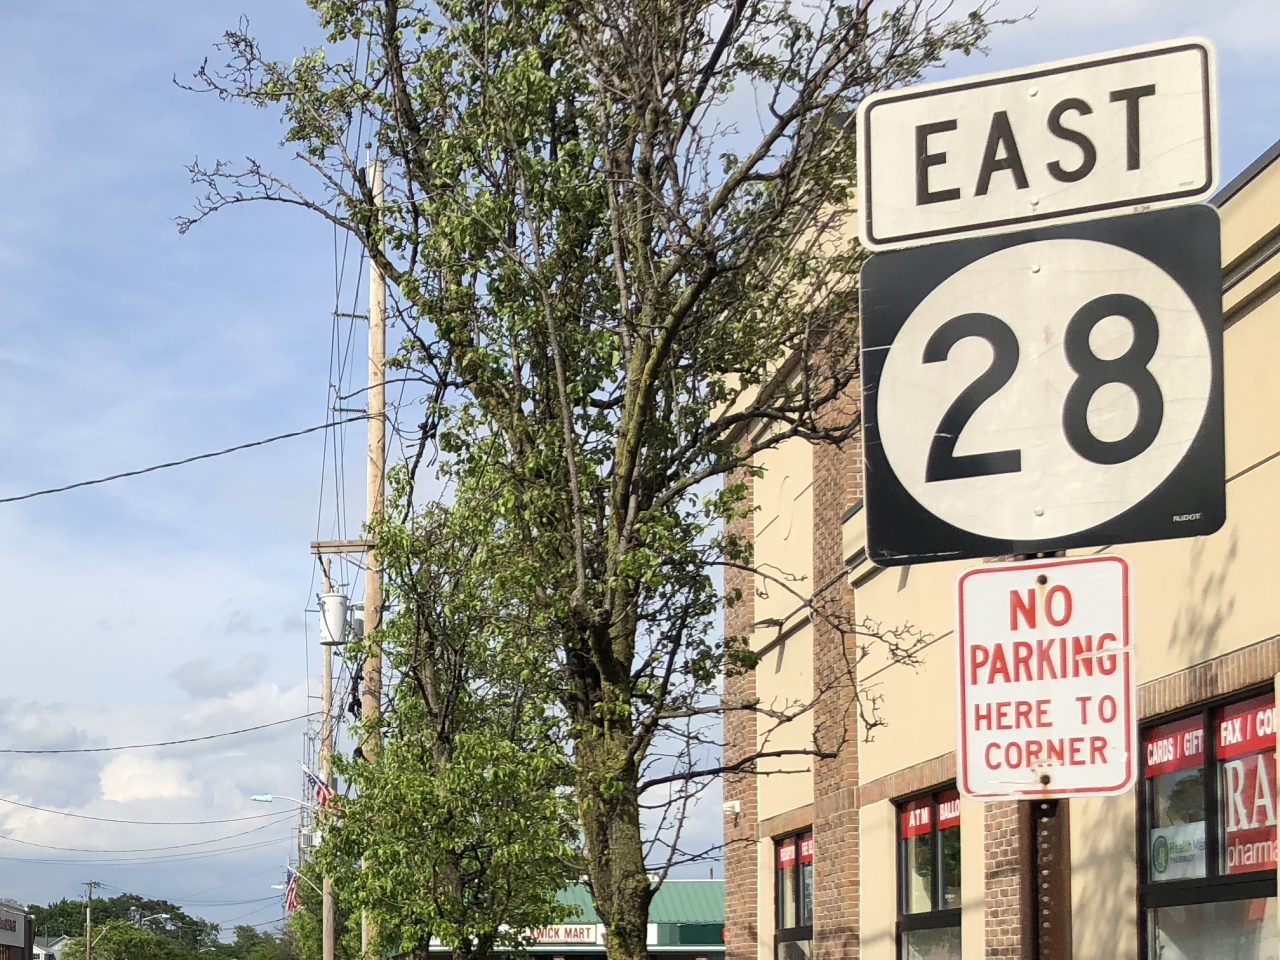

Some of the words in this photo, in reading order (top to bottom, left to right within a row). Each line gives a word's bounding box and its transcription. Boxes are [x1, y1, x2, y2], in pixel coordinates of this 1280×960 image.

[915, 84, 1156, 206] EAST
[922, 293, 1164, 483] 28
[1009, 584, 1073, 631] NO
[970, 632, 1117, 685] PARKING
[974, 699, 1053, 731] HERE
[1075, 695, 1117, 725] TO
[1221, 717, 1243, 747] FAX
[984, 736, 1108, 770] CORNER
[1147, 737, 1174, 766] CARDS
[1224, 753, 1277, 832] RA
[909, 807, 930, 828] ATM
[530, 927, 560, 939] KWICK
[564, 927, 592, 939] MART
